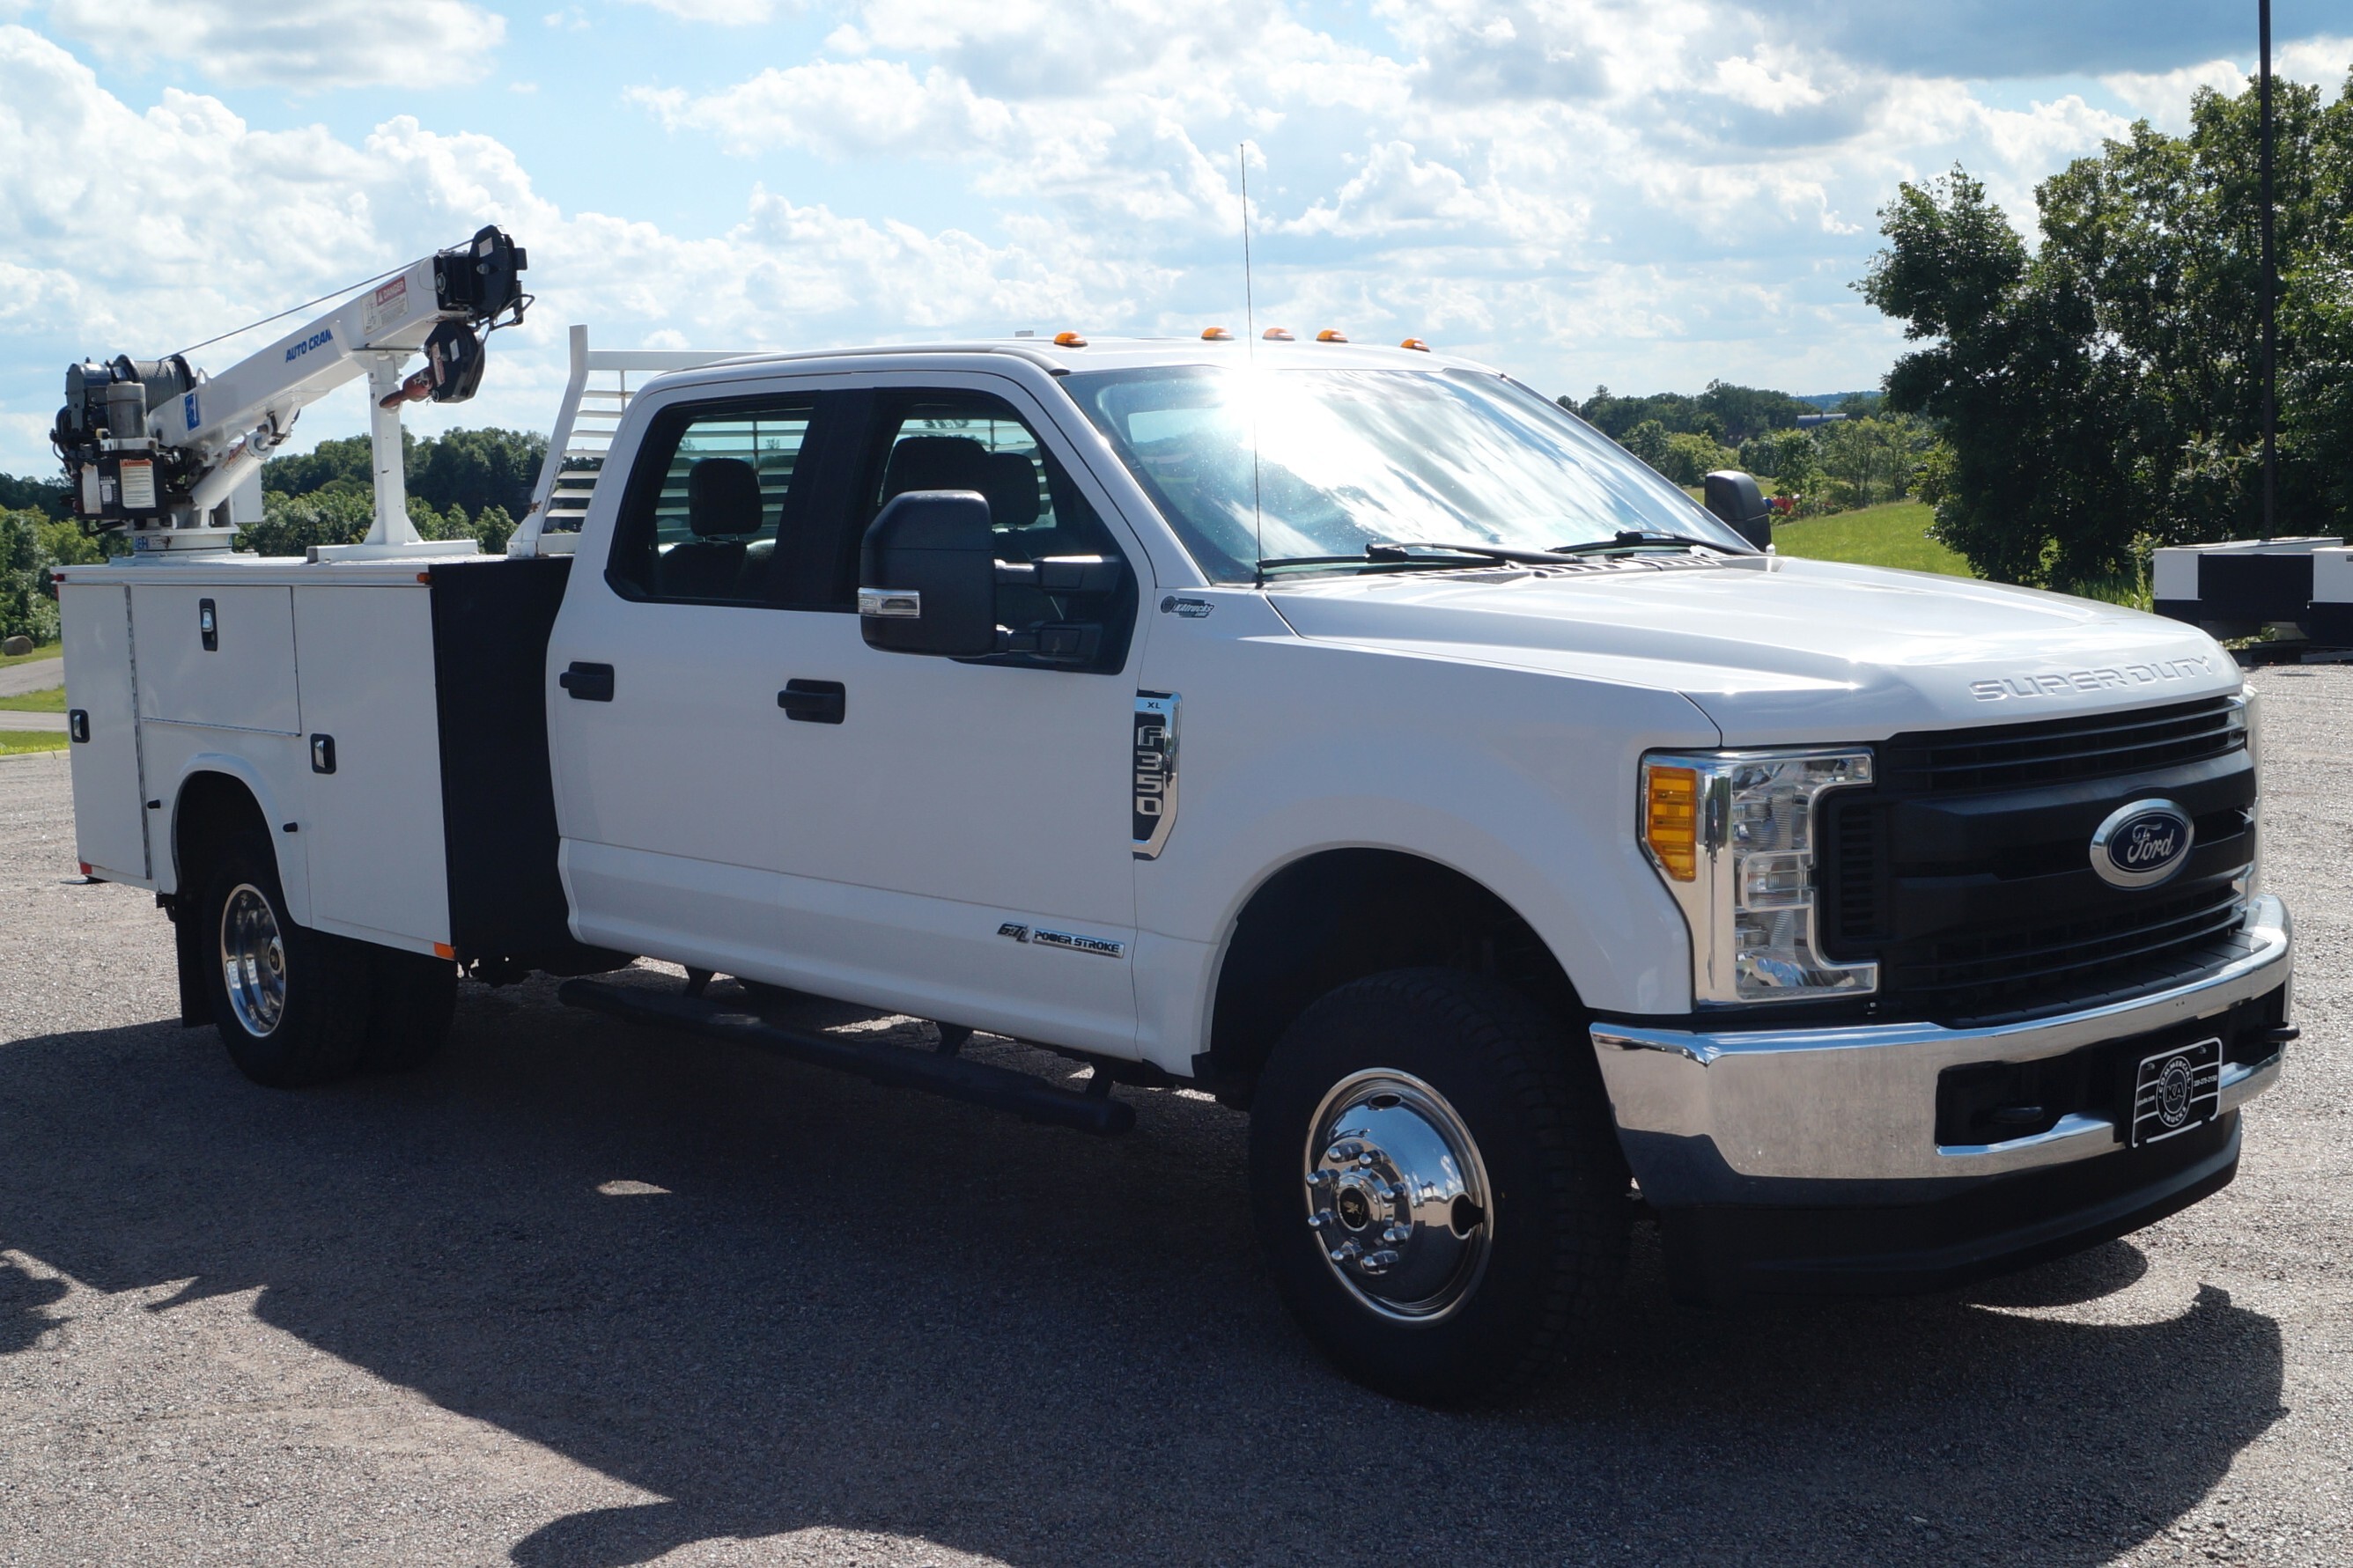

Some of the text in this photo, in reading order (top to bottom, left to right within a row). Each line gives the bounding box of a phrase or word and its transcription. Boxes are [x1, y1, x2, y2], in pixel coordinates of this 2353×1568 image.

[285, 328, 333, 363] AUTO CRAN
[1969, 657, 2212, 702] SUPER DUTY
[1147, 701, 1161, 710] XL
[1137, 725, 1163, 815] F350
[2127, 822, 2174, 864] Ford
[1035, 930, 1072, 945] POWER
[1073, 938, 1120, 953] STROKE
[2158, 1060, 2191, 1093] COMMERCIAL
[2166, 1082, 2185, 1103] KA
[2163, 1107, 2187, 1123] TRUCKS
